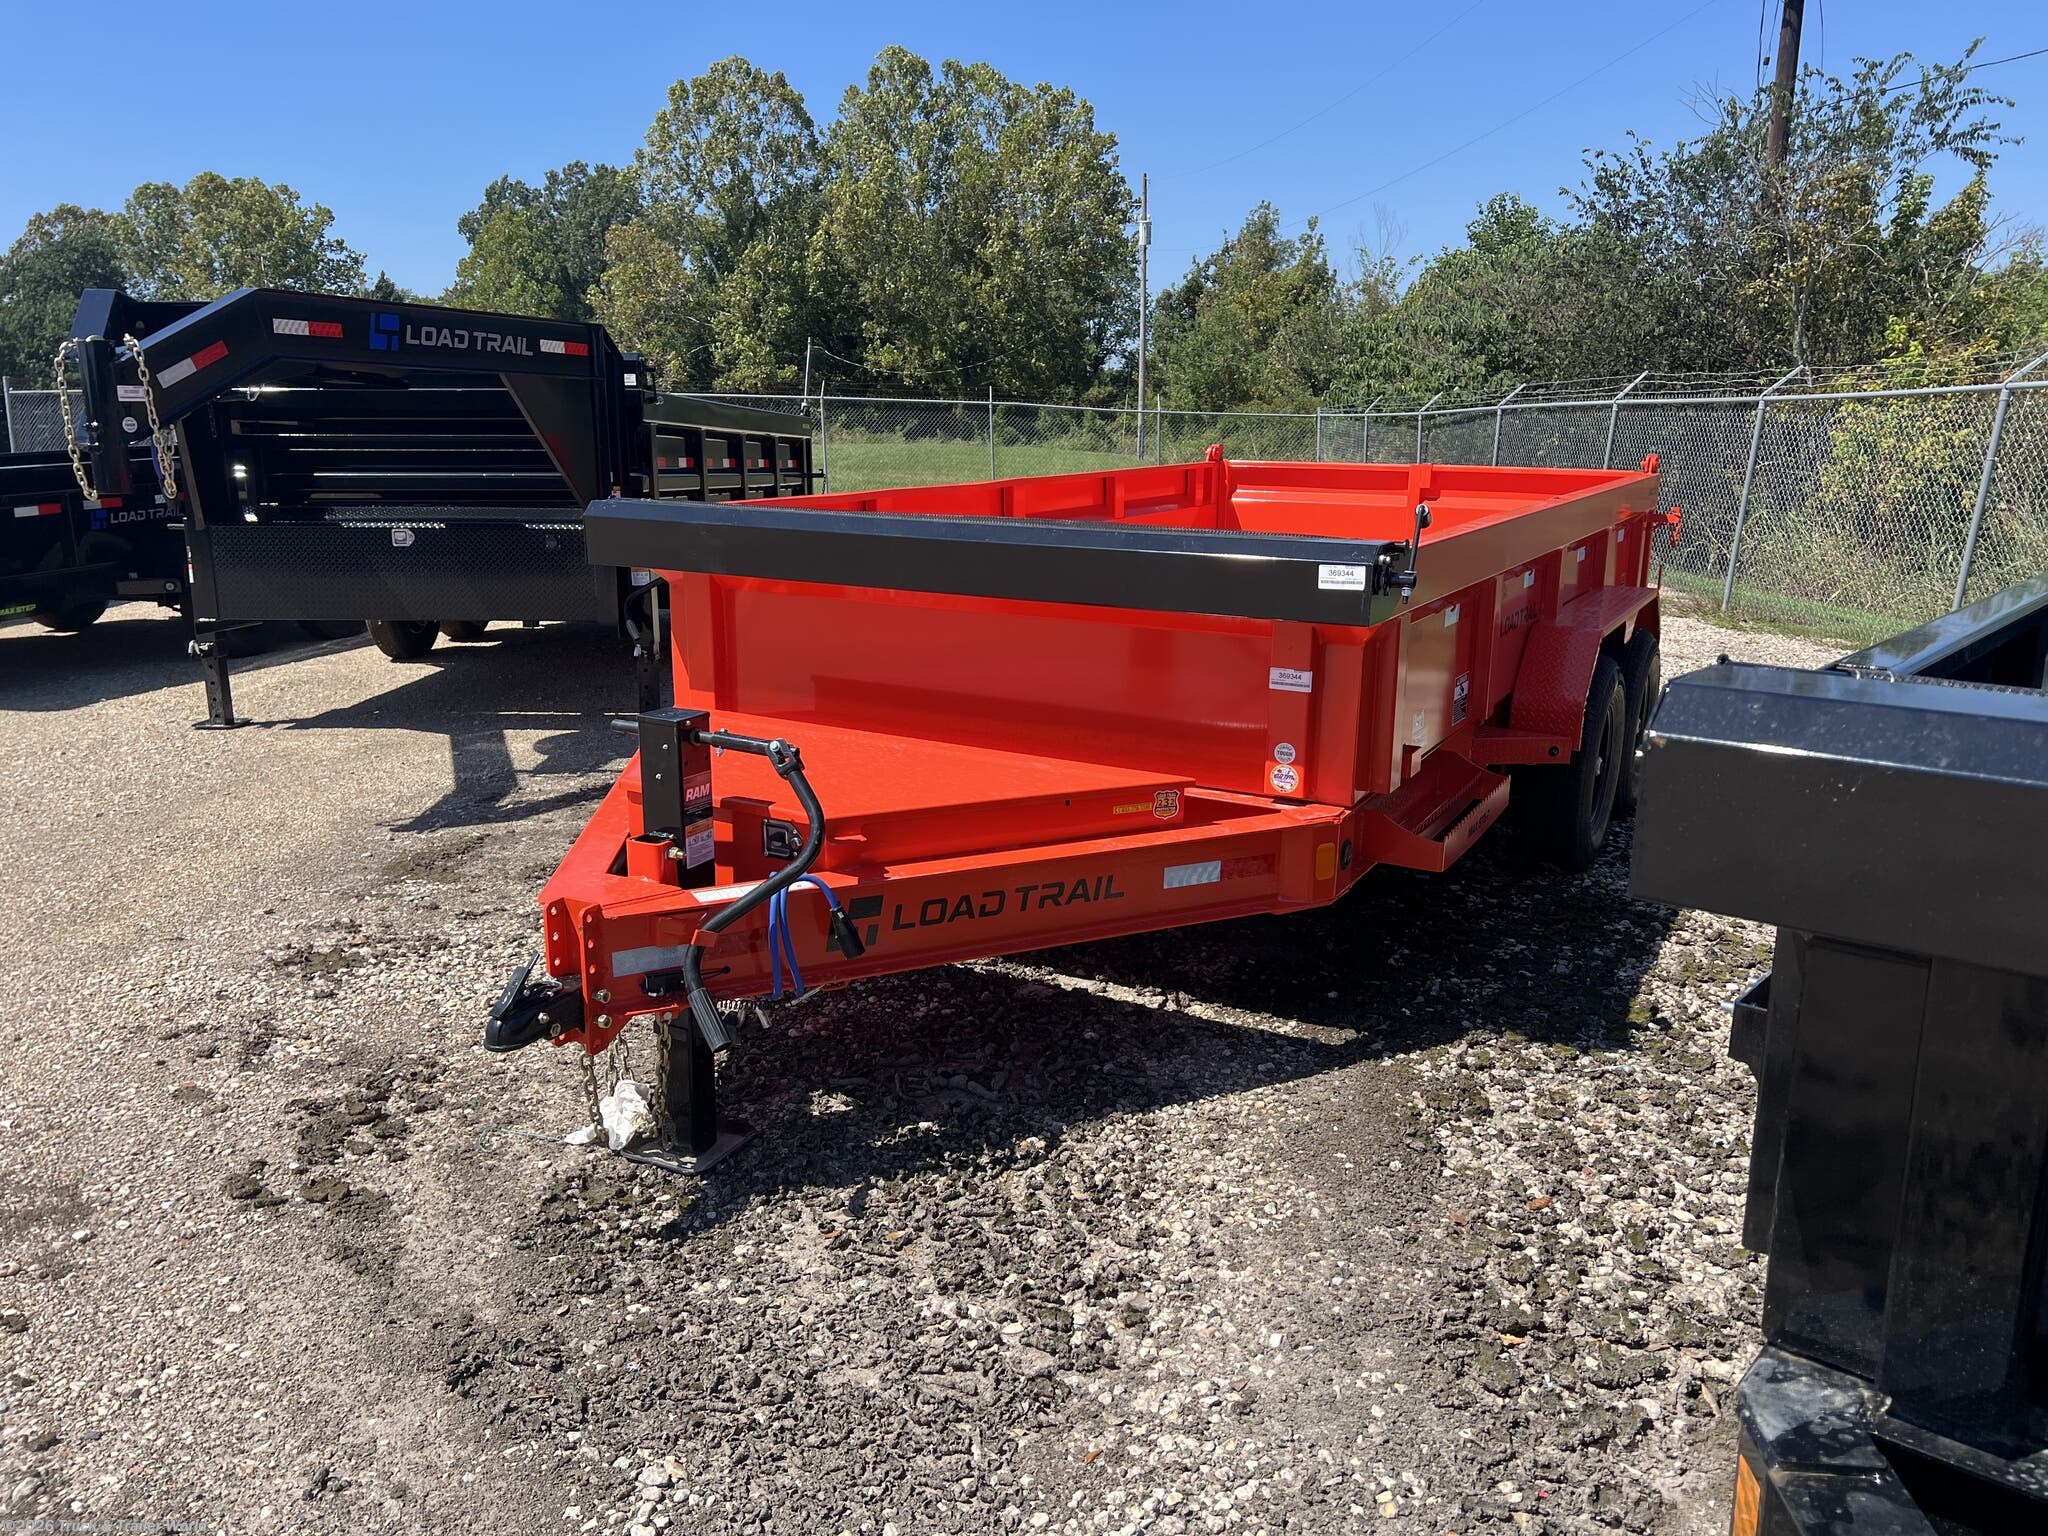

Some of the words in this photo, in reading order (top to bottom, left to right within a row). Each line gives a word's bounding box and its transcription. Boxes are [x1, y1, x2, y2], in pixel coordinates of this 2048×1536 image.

[405, 324, 469, 349] LOAD
[472, 331, 534, 356] TRAIL
[110, 510, 146, 524] LOAD
[147, 506, 184, 519] TRAIL
[1328, 569, 1354, 577] 369344
[1278, 672, 1302, 680] 369344
[685, 783, 710, 801] RAM
[892, 890, 1006, 931] LOAD
[1015, 874, 1125, 912] TRAIL
